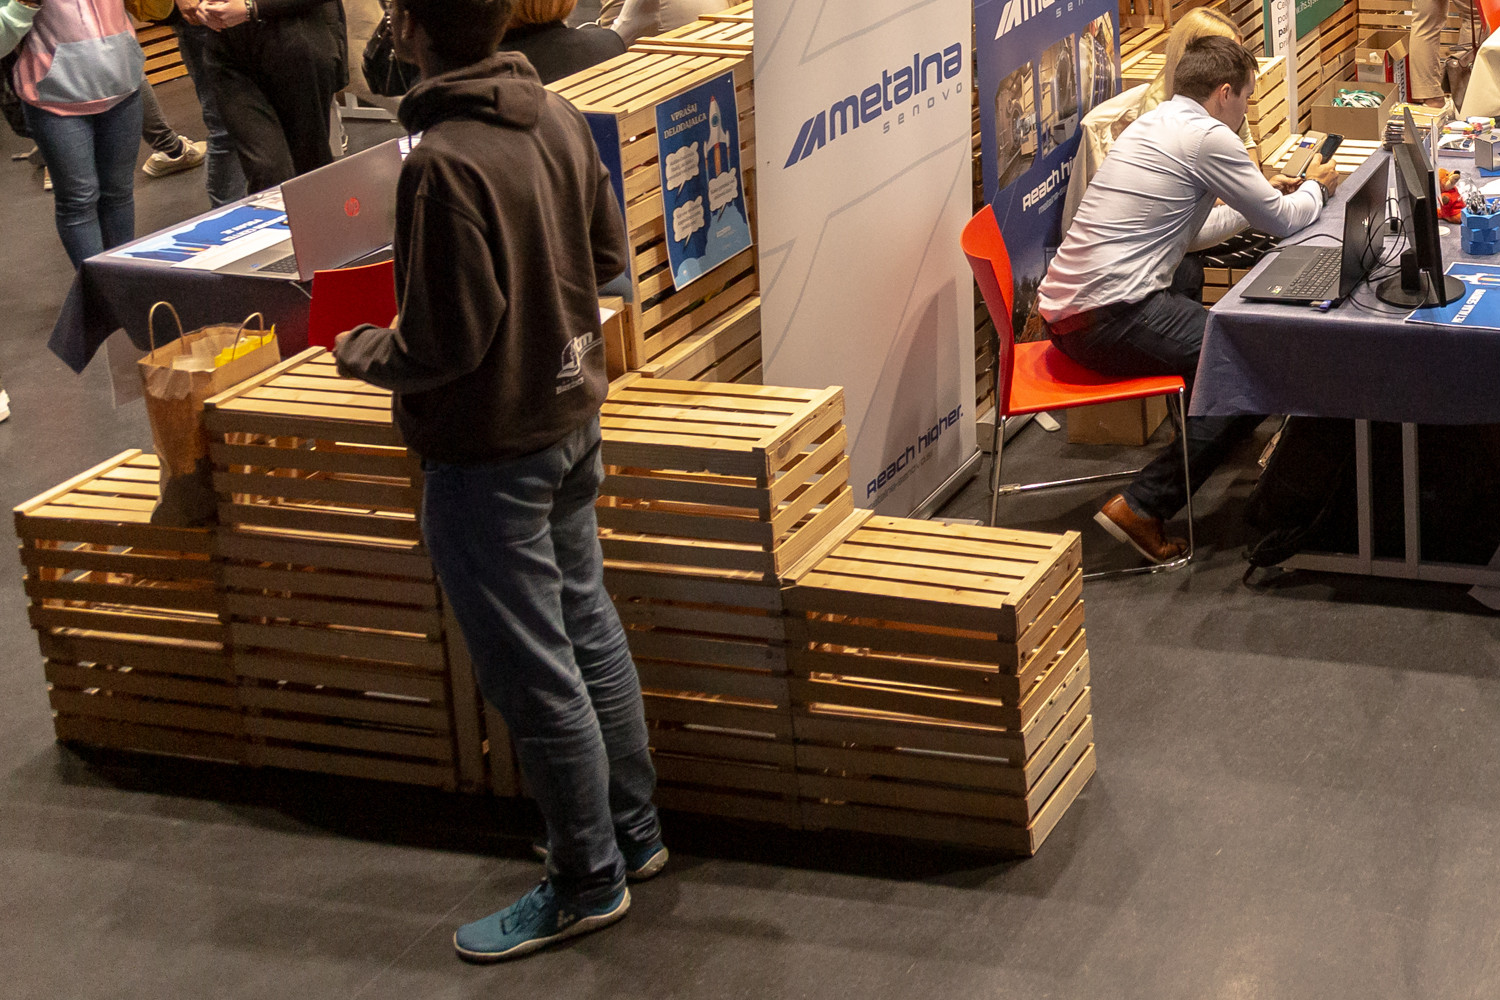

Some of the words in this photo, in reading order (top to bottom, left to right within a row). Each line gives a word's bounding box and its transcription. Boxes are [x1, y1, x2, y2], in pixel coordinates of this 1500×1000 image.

[670, 102, 698, 122] VPRAŠAJ
[830, 42, 962, 142] metalna
[883, 82, 963, 134] senovo
[663, 114, 708, 140] DELODAJALCA
[1022, 169, 1060, 212] Reach
[867, 445, 916, 499] Reach
[918, 404, 964, 454] higher.
